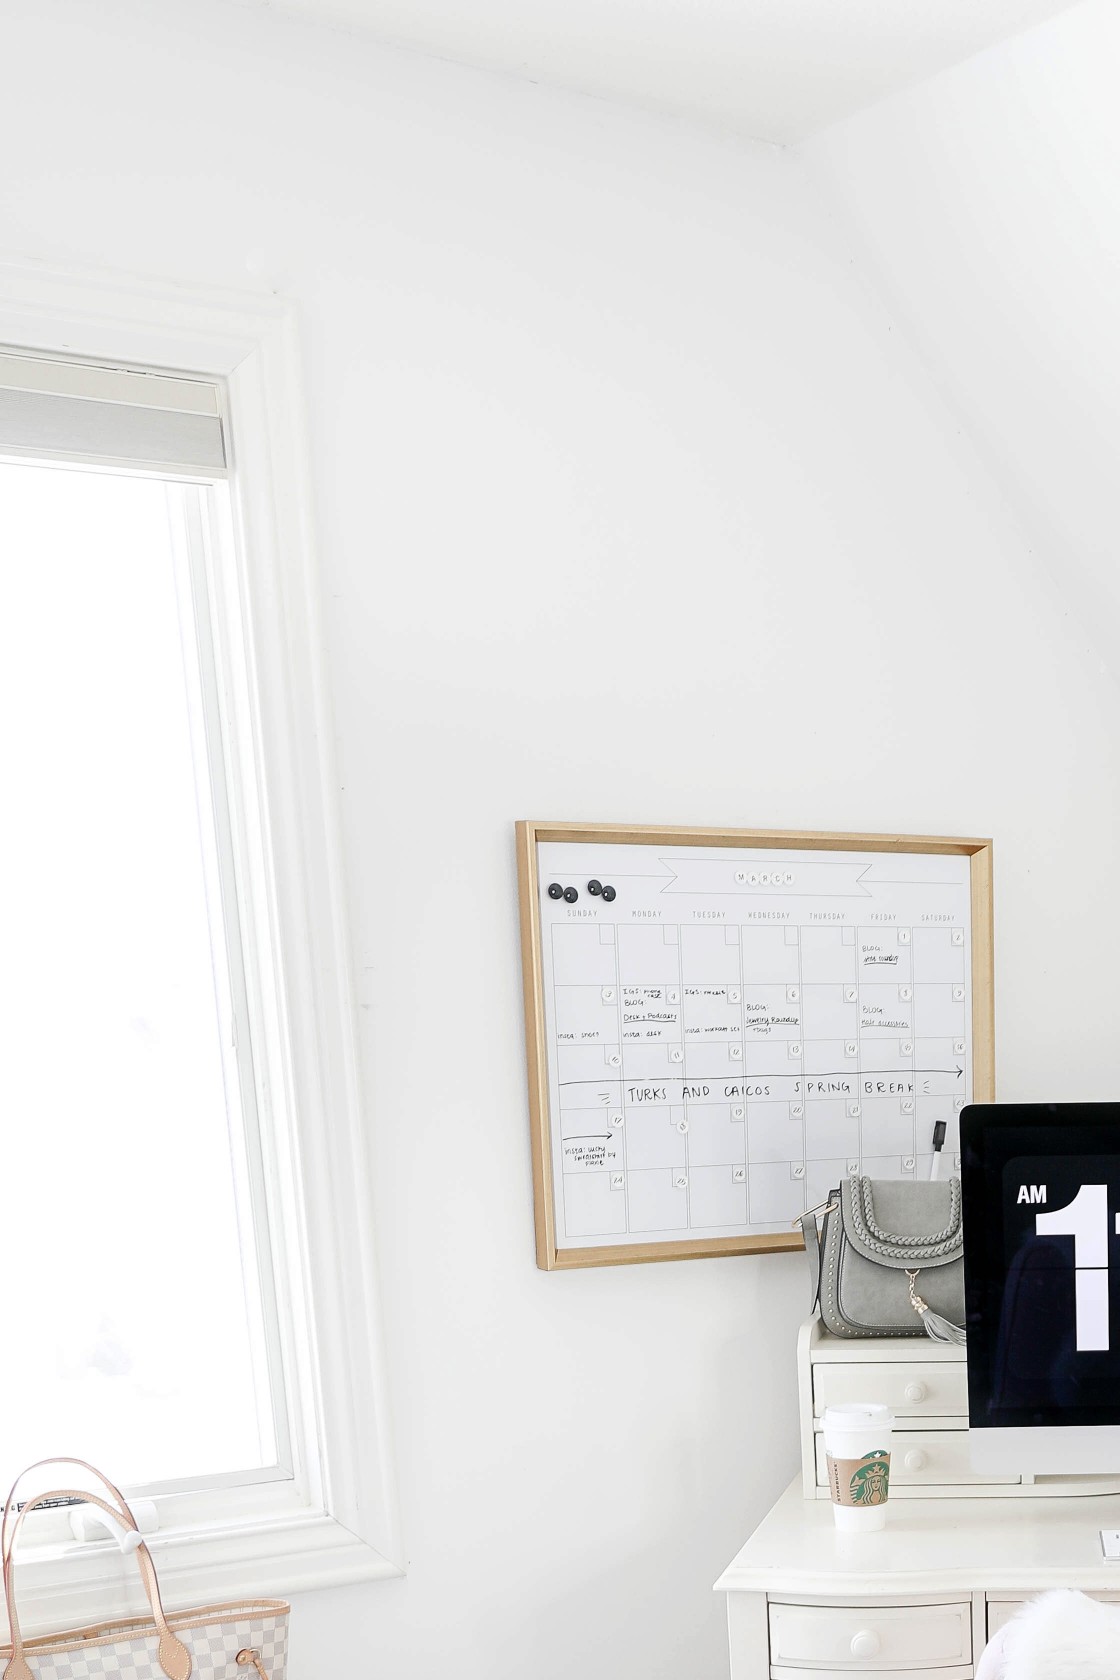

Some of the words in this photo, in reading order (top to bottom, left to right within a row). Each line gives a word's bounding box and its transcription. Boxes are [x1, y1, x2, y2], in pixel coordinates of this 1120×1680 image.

[738, 874, 792, 882] MARCH
[809, 912, 845, 920] THURSDAY
[921, 914, 955, 922] SATURDAY
[627, 1087, 667, 1102] TURKS
[682, 1086, 710, 1099] AND
[724, 1085, 770, 1097] CAICOS
[794, 1081, 851, 1093] SPRING
[865, 1082, 914, 1093] BREAK
[1017, 1184, 1047, 1204] AM
[833, 1463, 841, 1502] STARBUCKS
